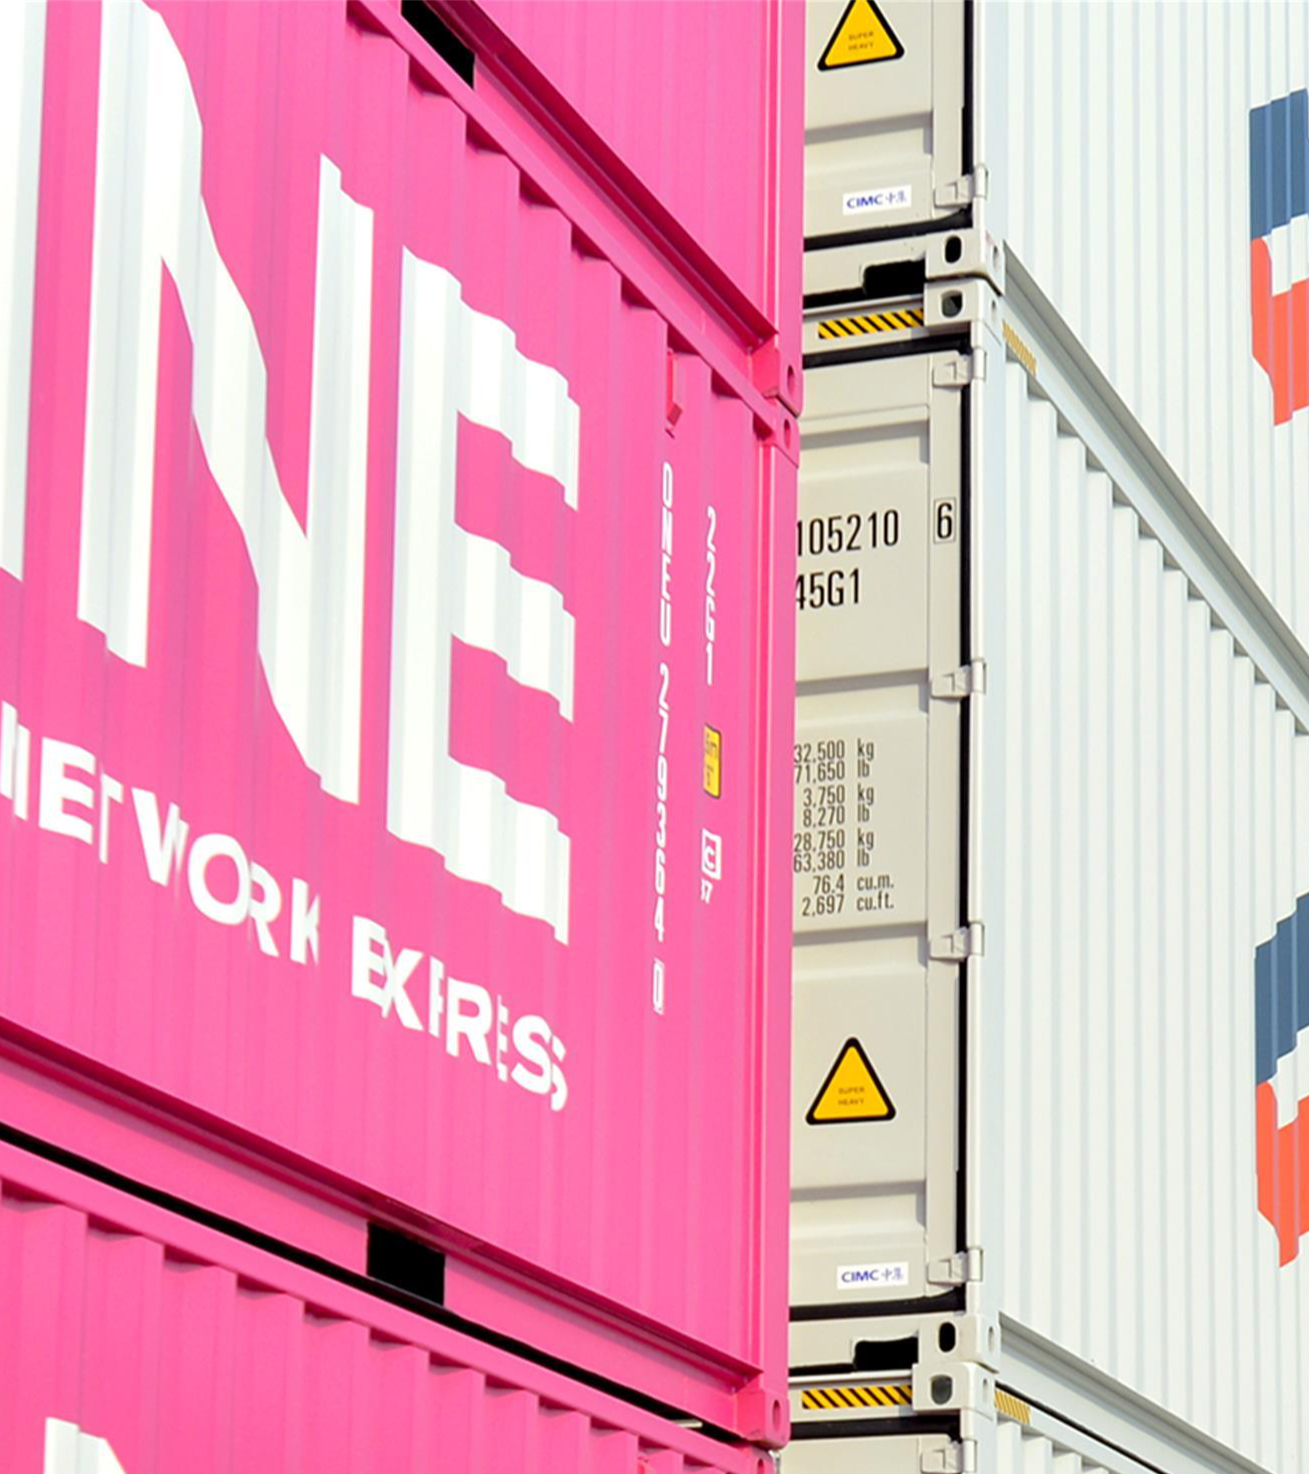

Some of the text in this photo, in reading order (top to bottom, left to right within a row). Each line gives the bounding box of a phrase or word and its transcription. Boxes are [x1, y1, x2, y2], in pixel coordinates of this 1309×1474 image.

[846, 193, 883, 209] CIMC
[797, 502, 952, 556] 105210 6
[796, 567, 859, 611] 45G1
[857, 738, 874, 761] kg
[857, 760, 870, 777] lb
[857, 783, 874, 806] kg
[857, 805, 870, 822] lb
[857, 828, 874, 850] kg
[857, 849, 870, 867] lb
[857, 874, 894, 891] cu.m.
[856, 891, 894, 911] cu.ft.
[841, 1269, 880, 1283] CIMC
